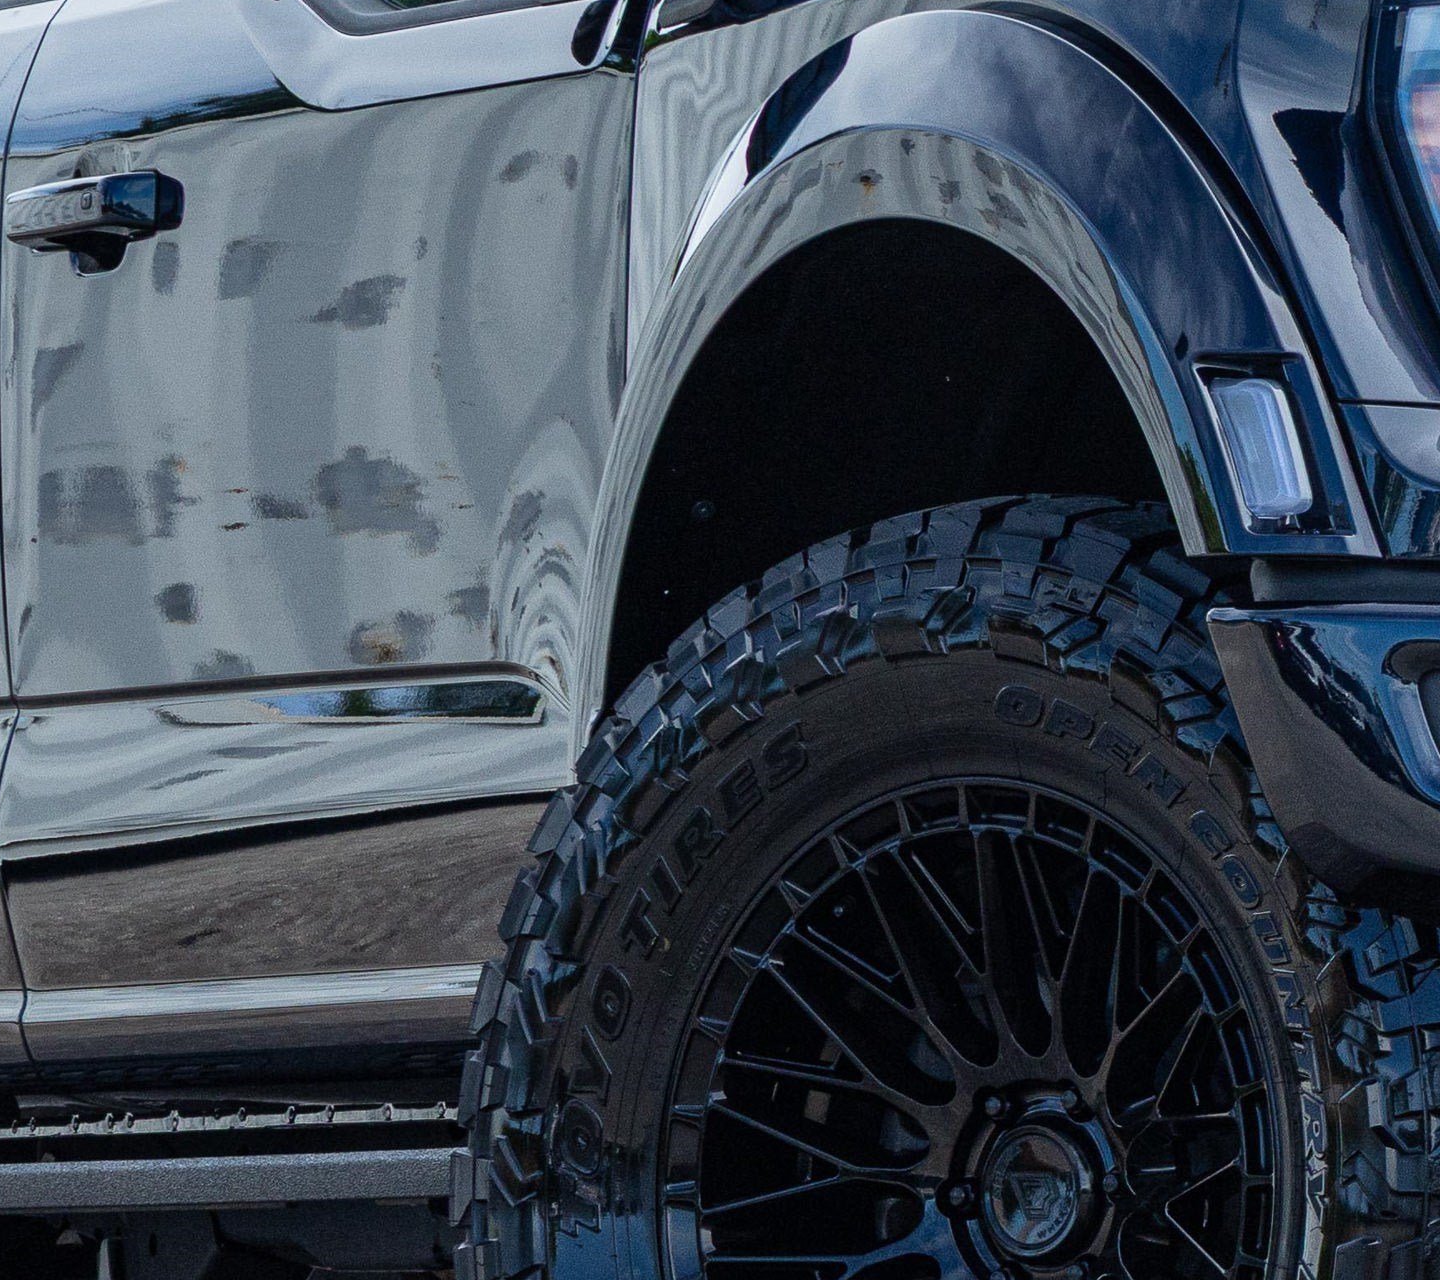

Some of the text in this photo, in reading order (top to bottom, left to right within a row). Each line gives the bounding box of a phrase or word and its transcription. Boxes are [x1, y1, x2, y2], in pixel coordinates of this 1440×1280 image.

[553, 718, 811, 1238] TOYO TIRES
[993, 683, 1191, 809] OPEN
[1187, 808, 1332, 1235] COUNTRY
